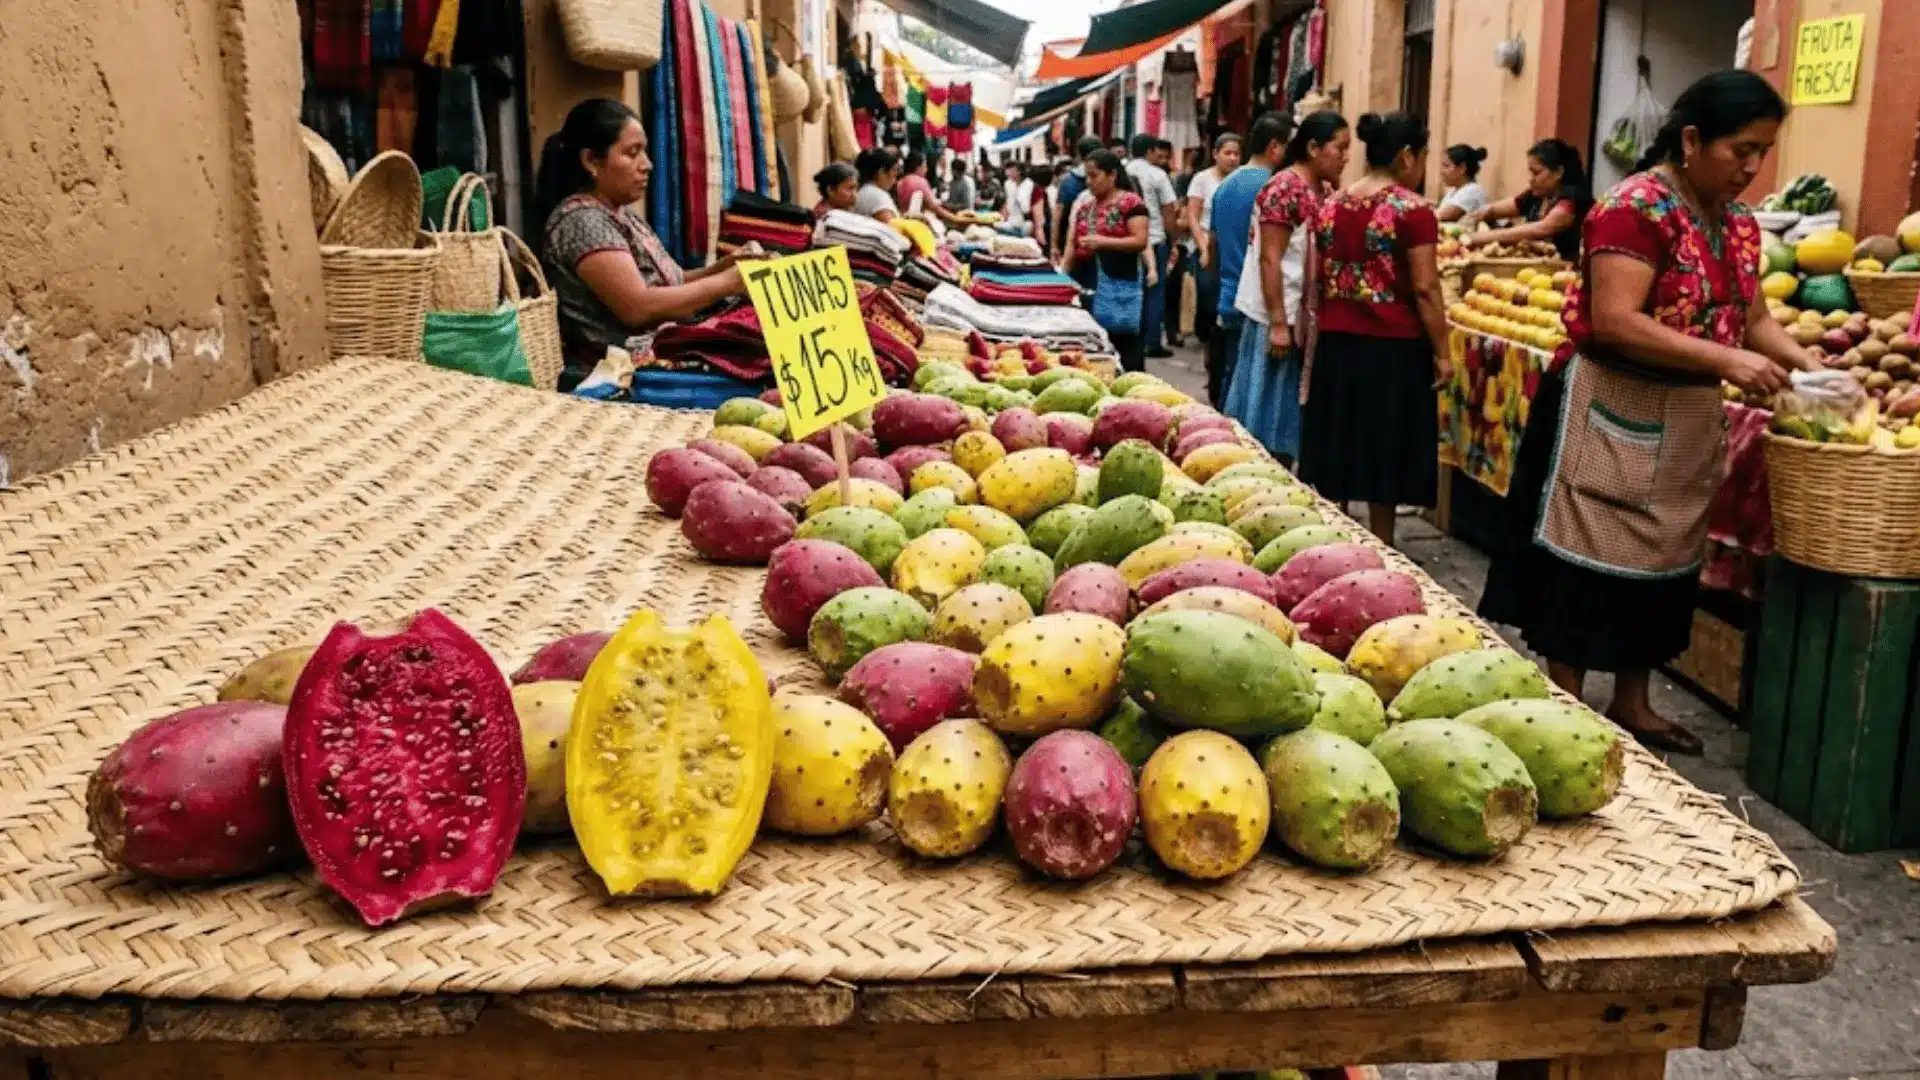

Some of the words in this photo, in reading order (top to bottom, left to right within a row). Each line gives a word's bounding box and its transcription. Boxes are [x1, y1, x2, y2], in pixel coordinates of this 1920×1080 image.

[1801, 20, 1853, 55] FRUTA
[1796, 61, 1852, 95] FRESCA
[749, 254, 849, 328] TUNAS
[847, 346, 878, 397] Kg
